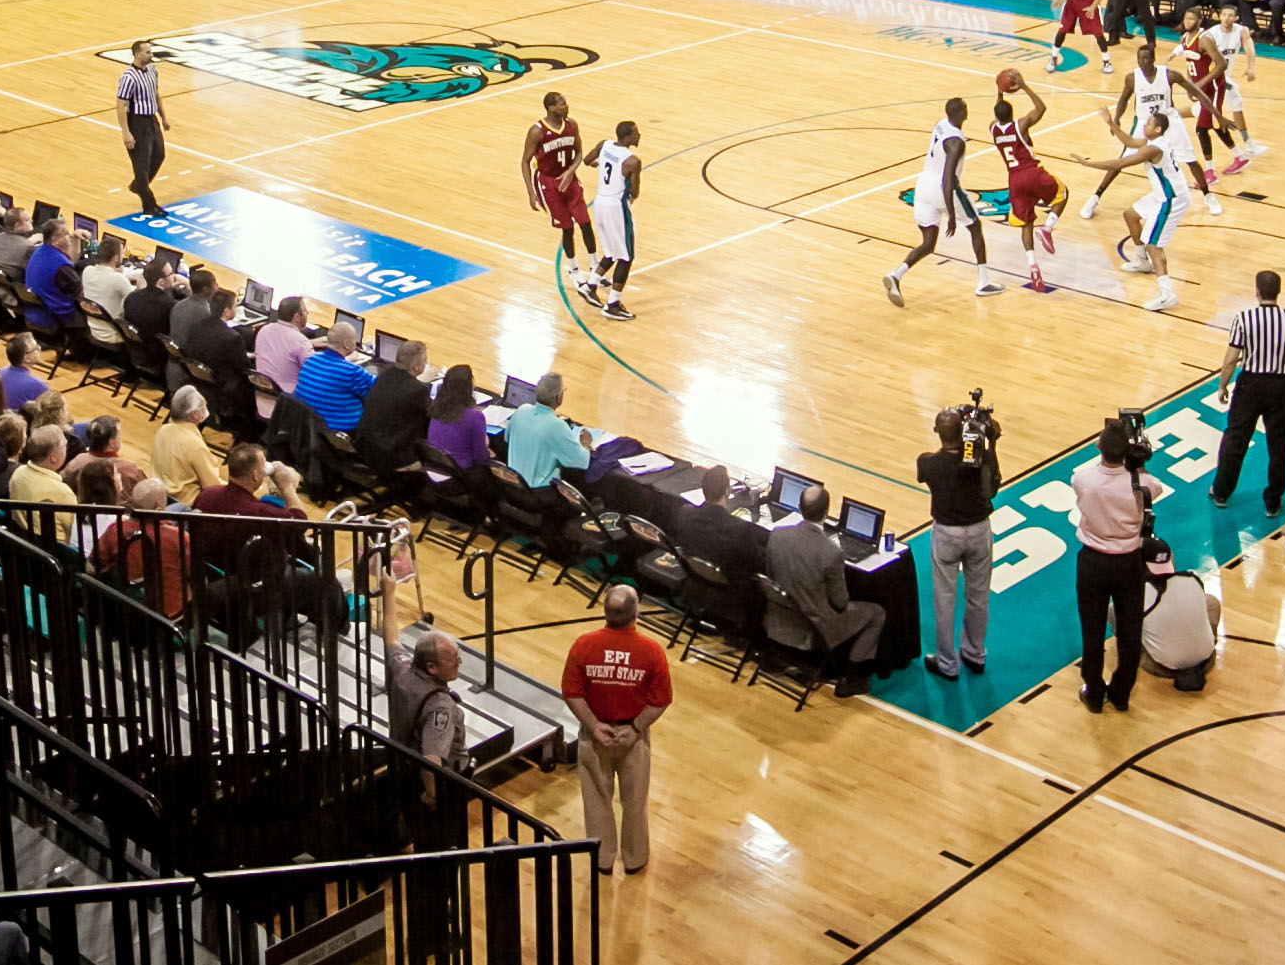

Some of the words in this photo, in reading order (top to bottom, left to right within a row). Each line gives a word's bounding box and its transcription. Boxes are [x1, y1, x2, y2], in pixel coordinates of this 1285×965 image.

[557, 150, 566, 168] 4
[1003, 146, 1019, 168] 5
[603, 161, 612, 185] 3
[131, 213, 224, 248] SOUTH
[603, 649, 631, 665] EPI
[585, 665, 616, 678] EVENT
[616, 666, 646, 681] STAFF
